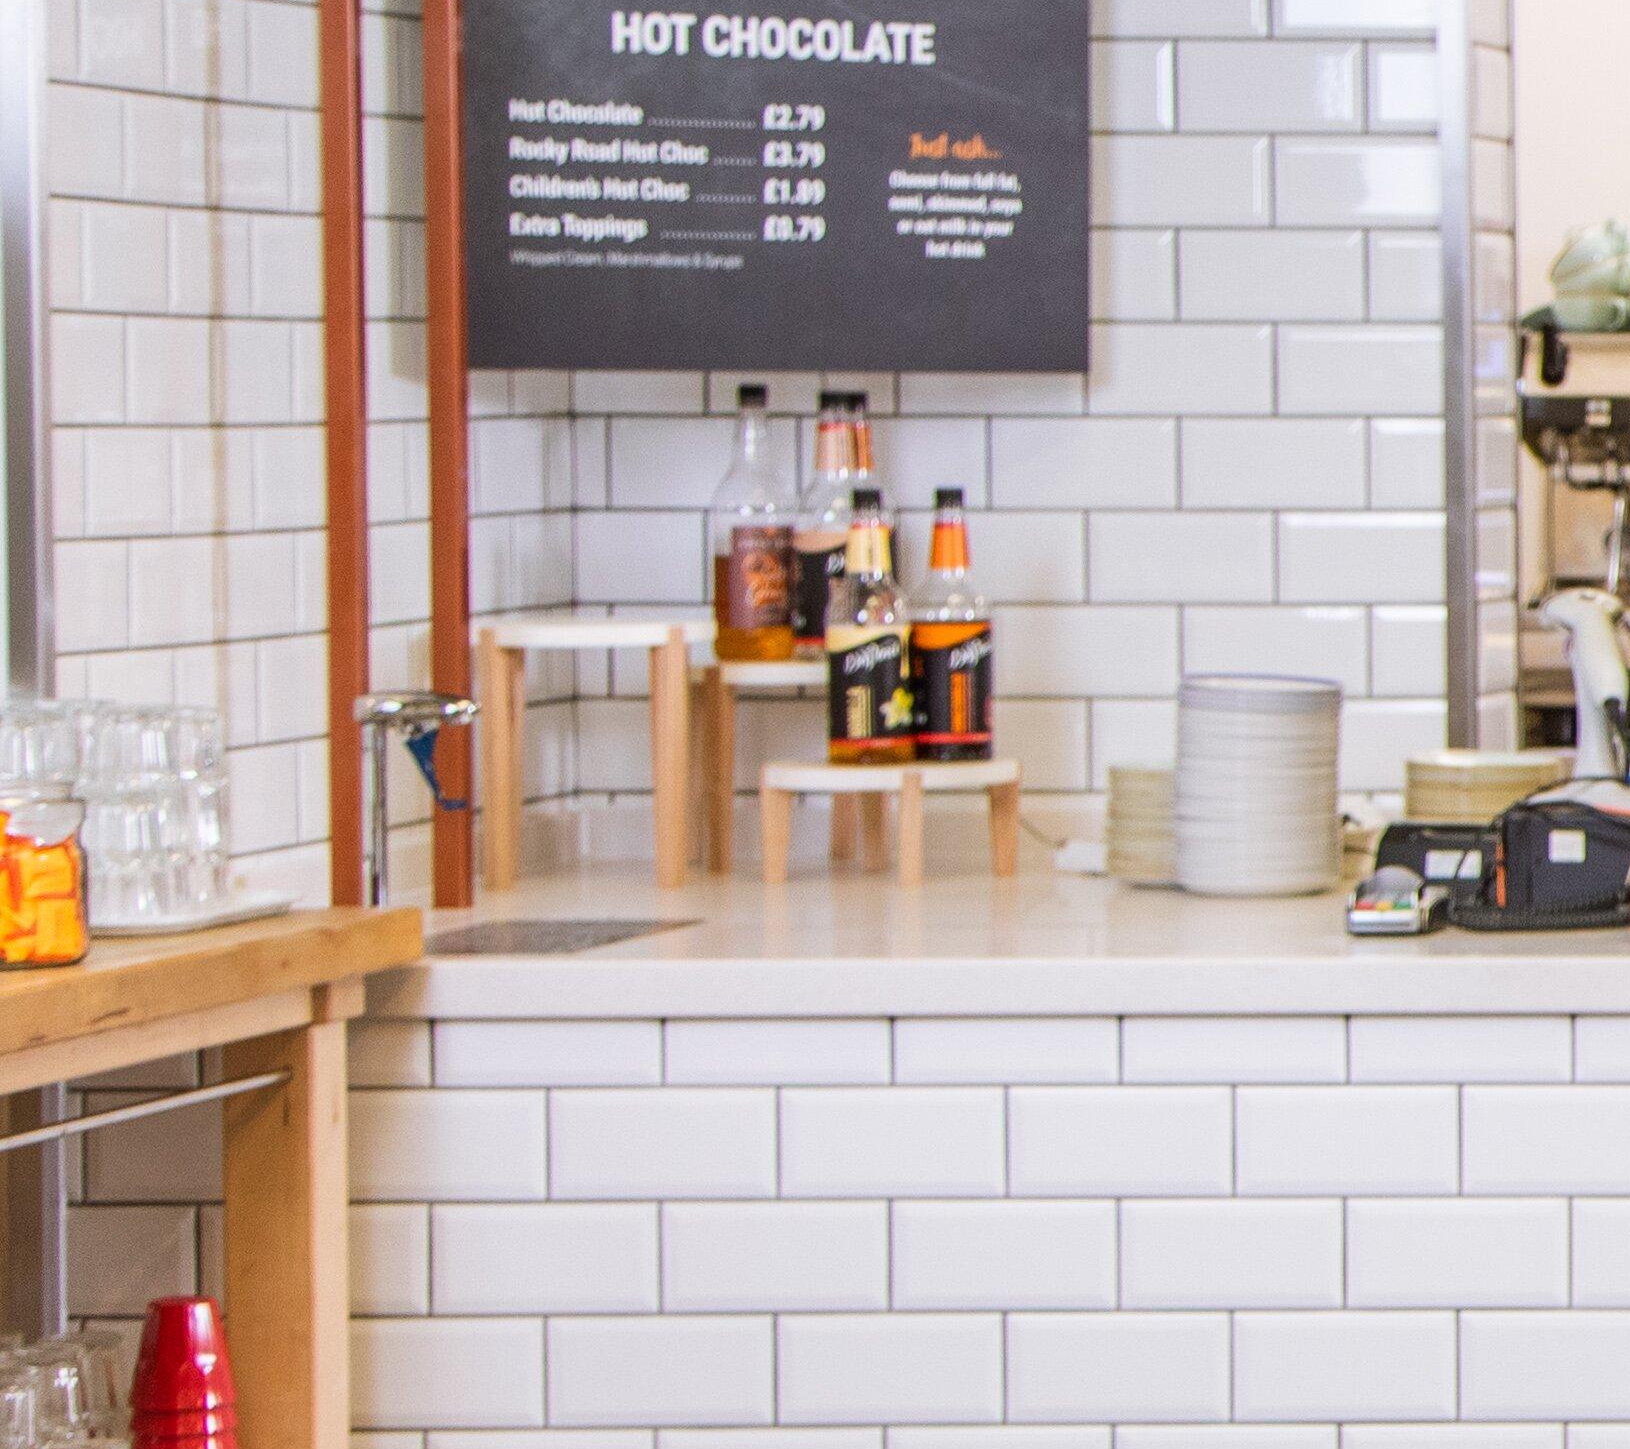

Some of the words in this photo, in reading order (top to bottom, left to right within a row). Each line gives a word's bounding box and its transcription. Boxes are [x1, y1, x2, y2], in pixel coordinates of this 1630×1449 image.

[611, 10, 697, 56] HOT
[702, 13, 936, 66] CHOCOLATE
[508, 98, 546, 123] Hot
[547, 99, 645, 126] Chocolate
[763, 103, 826, 131] £2.79
[509, 136, 569, 166] Rocky
[570, 138, 621, 162] Road
[622, 138, 658, 163] Hot
[659, 140, 710, 165] Choc
[763, 140, 826, 168] £3.79
[602, 176, 639, 201] Hot
[639, 177, 690, 202] Choc
[509, 212, 561, 237] Extra
[562, 213, 649, 243] Toppings
[763, 215, 826, 242] £0.79
